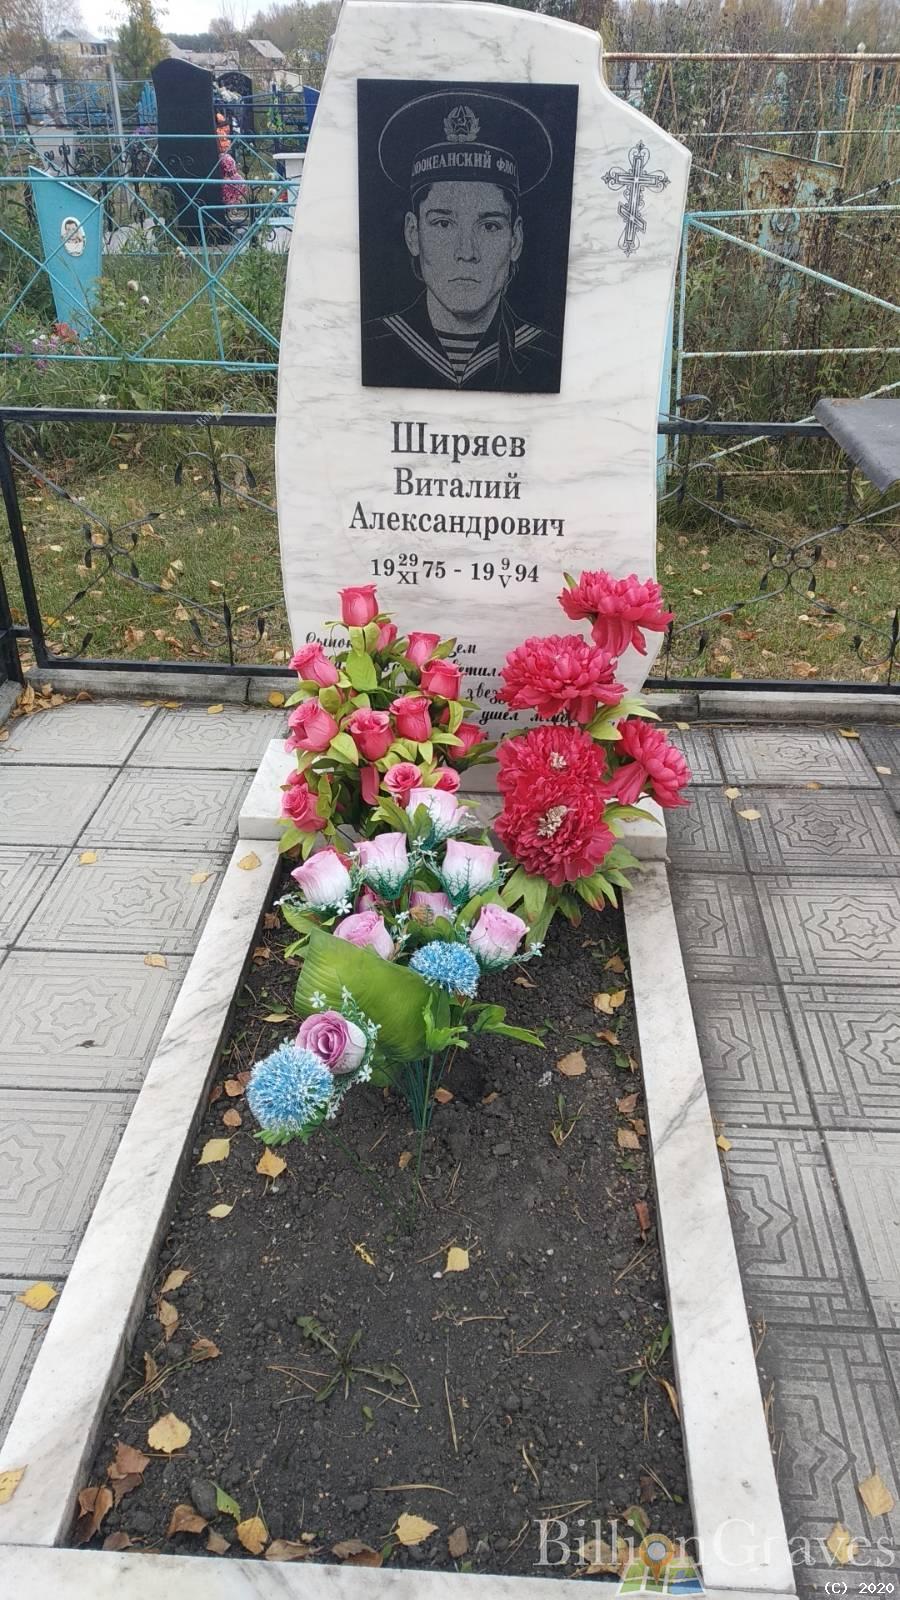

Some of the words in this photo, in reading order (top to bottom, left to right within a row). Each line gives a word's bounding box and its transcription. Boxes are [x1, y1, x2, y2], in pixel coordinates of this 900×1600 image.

[390, 421, 526, 463] Ширяев
[393, 467, 521, 499] Виталий
[349, 501, 566, 540] Александрович
